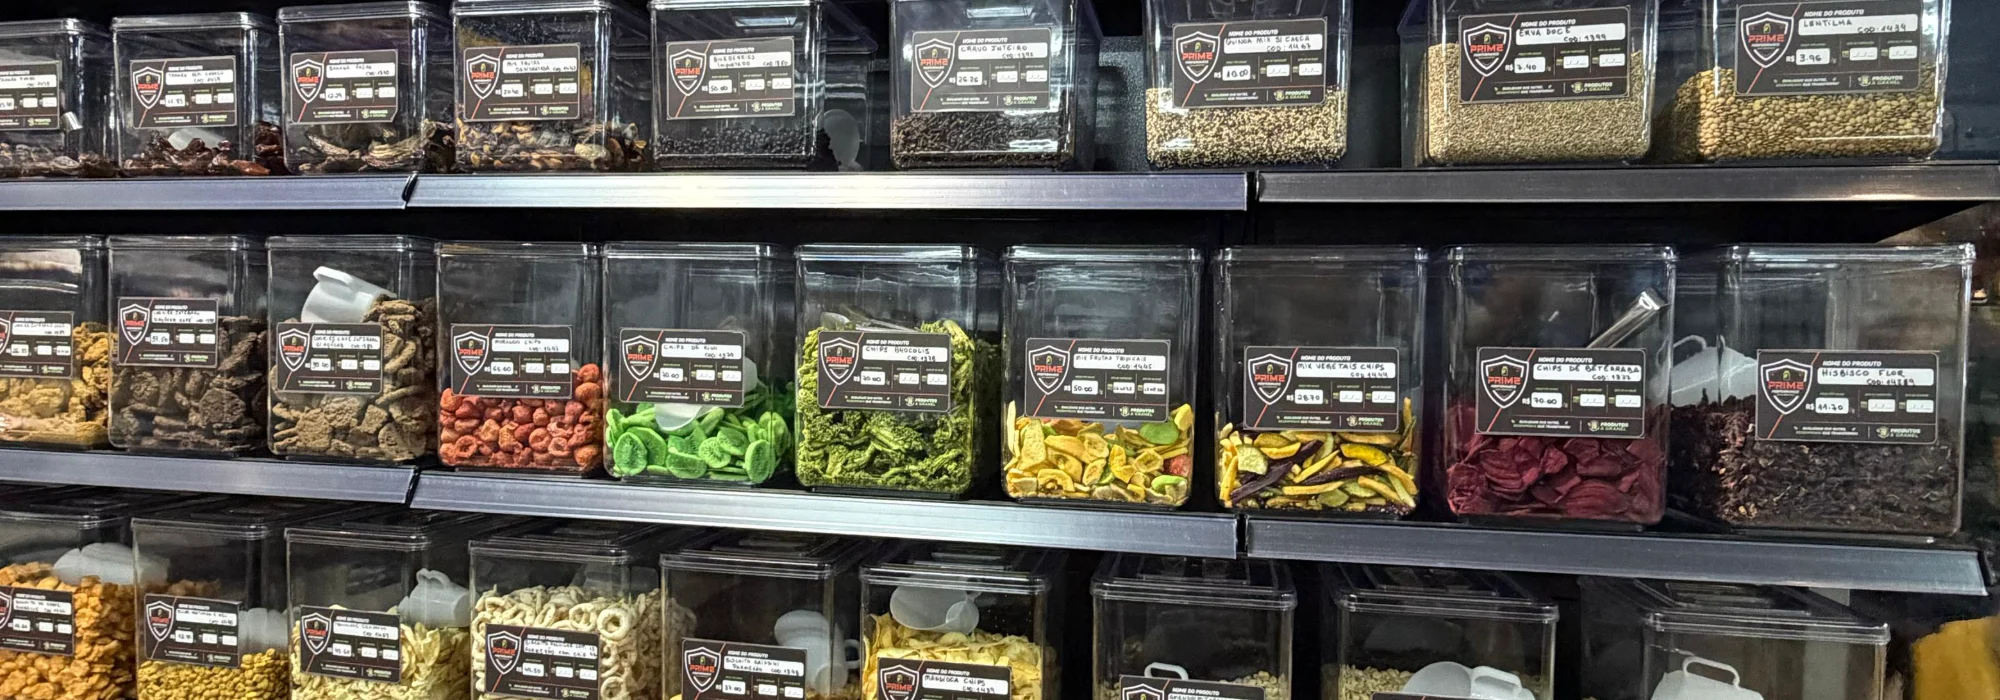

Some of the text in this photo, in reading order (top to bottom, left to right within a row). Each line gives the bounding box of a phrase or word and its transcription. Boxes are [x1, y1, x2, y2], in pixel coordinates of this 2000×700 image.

[1803, 20, 1852, 28] LENTILHA
[1519, 28, 1571, 38] ERVA DOCE
[1748, 34, 1785, 42] PRIME
[1470, 44, 1504, 53] PRIME
[1182, 52, 1213, 60] PRIME
[826, 356, 853, 364] PRIME
[1034, 365, 1063, 373] PRIME
[1254, 374, 1285, 382] PRIME
[1879, 370, 1905, 378] FLOR
[1488, 376, 1521, 385] PRIME
[1767, 381, 1805, 390] PRIME
[886, 683, 912, 691] PRIME
